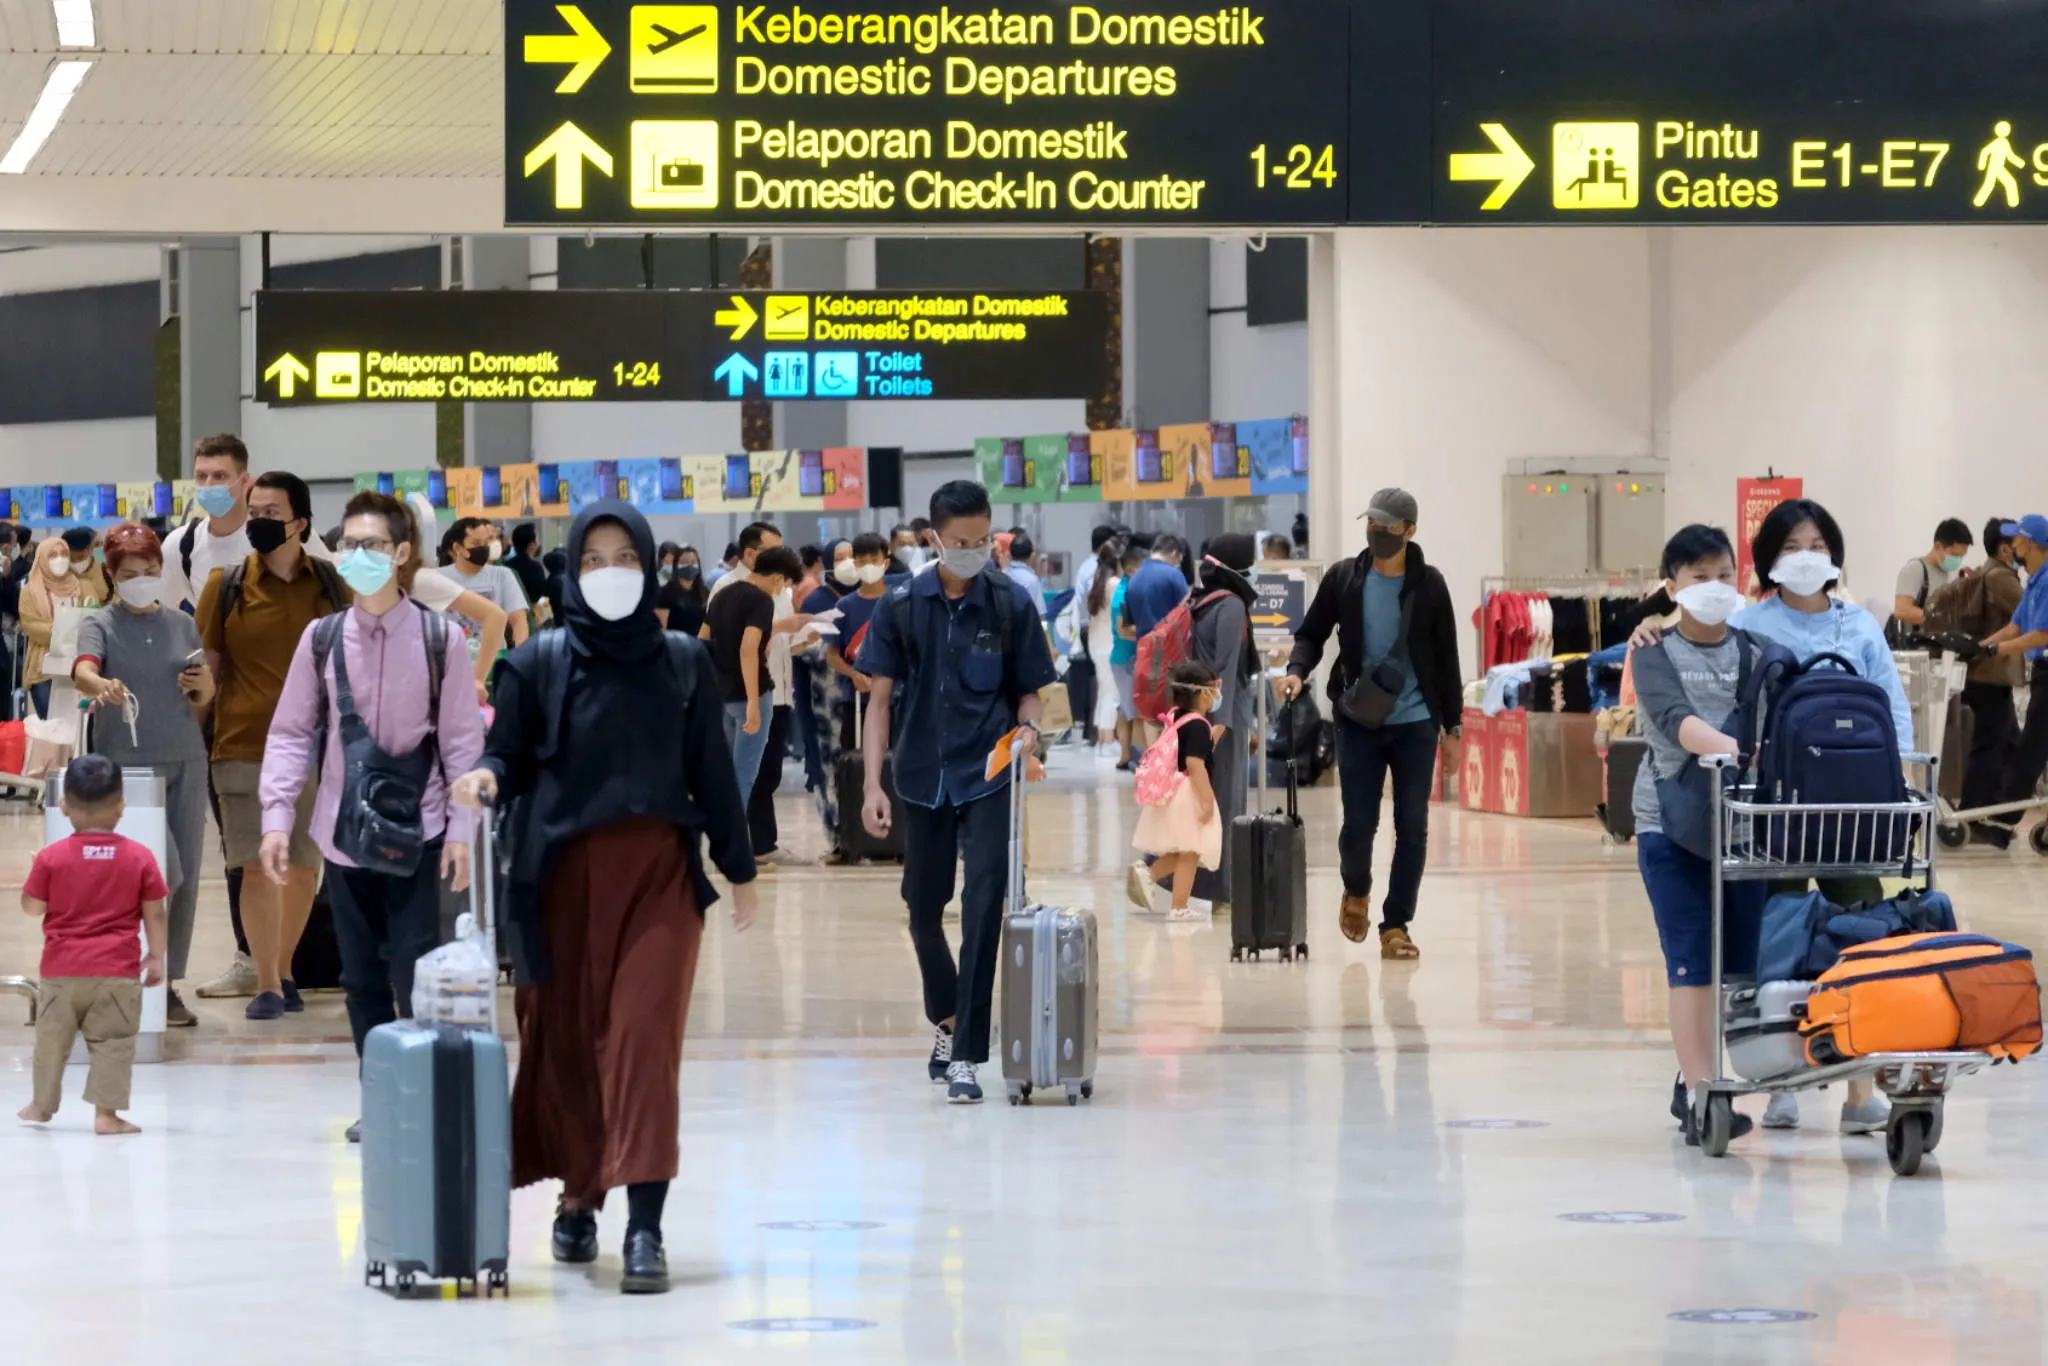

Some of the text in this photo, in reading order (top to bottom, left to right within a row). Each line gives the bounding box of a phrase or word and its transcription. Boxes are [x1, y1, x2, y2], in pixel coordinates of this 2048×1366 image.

[735, 5, 1265, 53] Keberangkatan Domestik
[735, 56, 1177, 102] Domestic Departures
[734, 119, 1128, 163] Pelaporan Domestik
[1655, 120, 1759, 159] Pintu
[1250, 143, 1337, 189] 1-24
[1791, 140, 1950, 188] E1-E7
[734, 169, 1206, 210] Domestic Check-In Counter
[1656, 168, 1779, 208] Gates
[815, 295, 1068, 319] Keberangkatan Domestik
[814, 319, 1026, 344] Domestic Departures
[366, 351, 559, 377] Pelaporan Domestik
[612, 361, 661, 387] 1-24
[865, 351, 922, 372] Toilet
[366, 375, 597, 398] Domestic Check-In Counter
[864, 375, 932, 397] Toilets
[1269, 598, 1285, 609] D7
